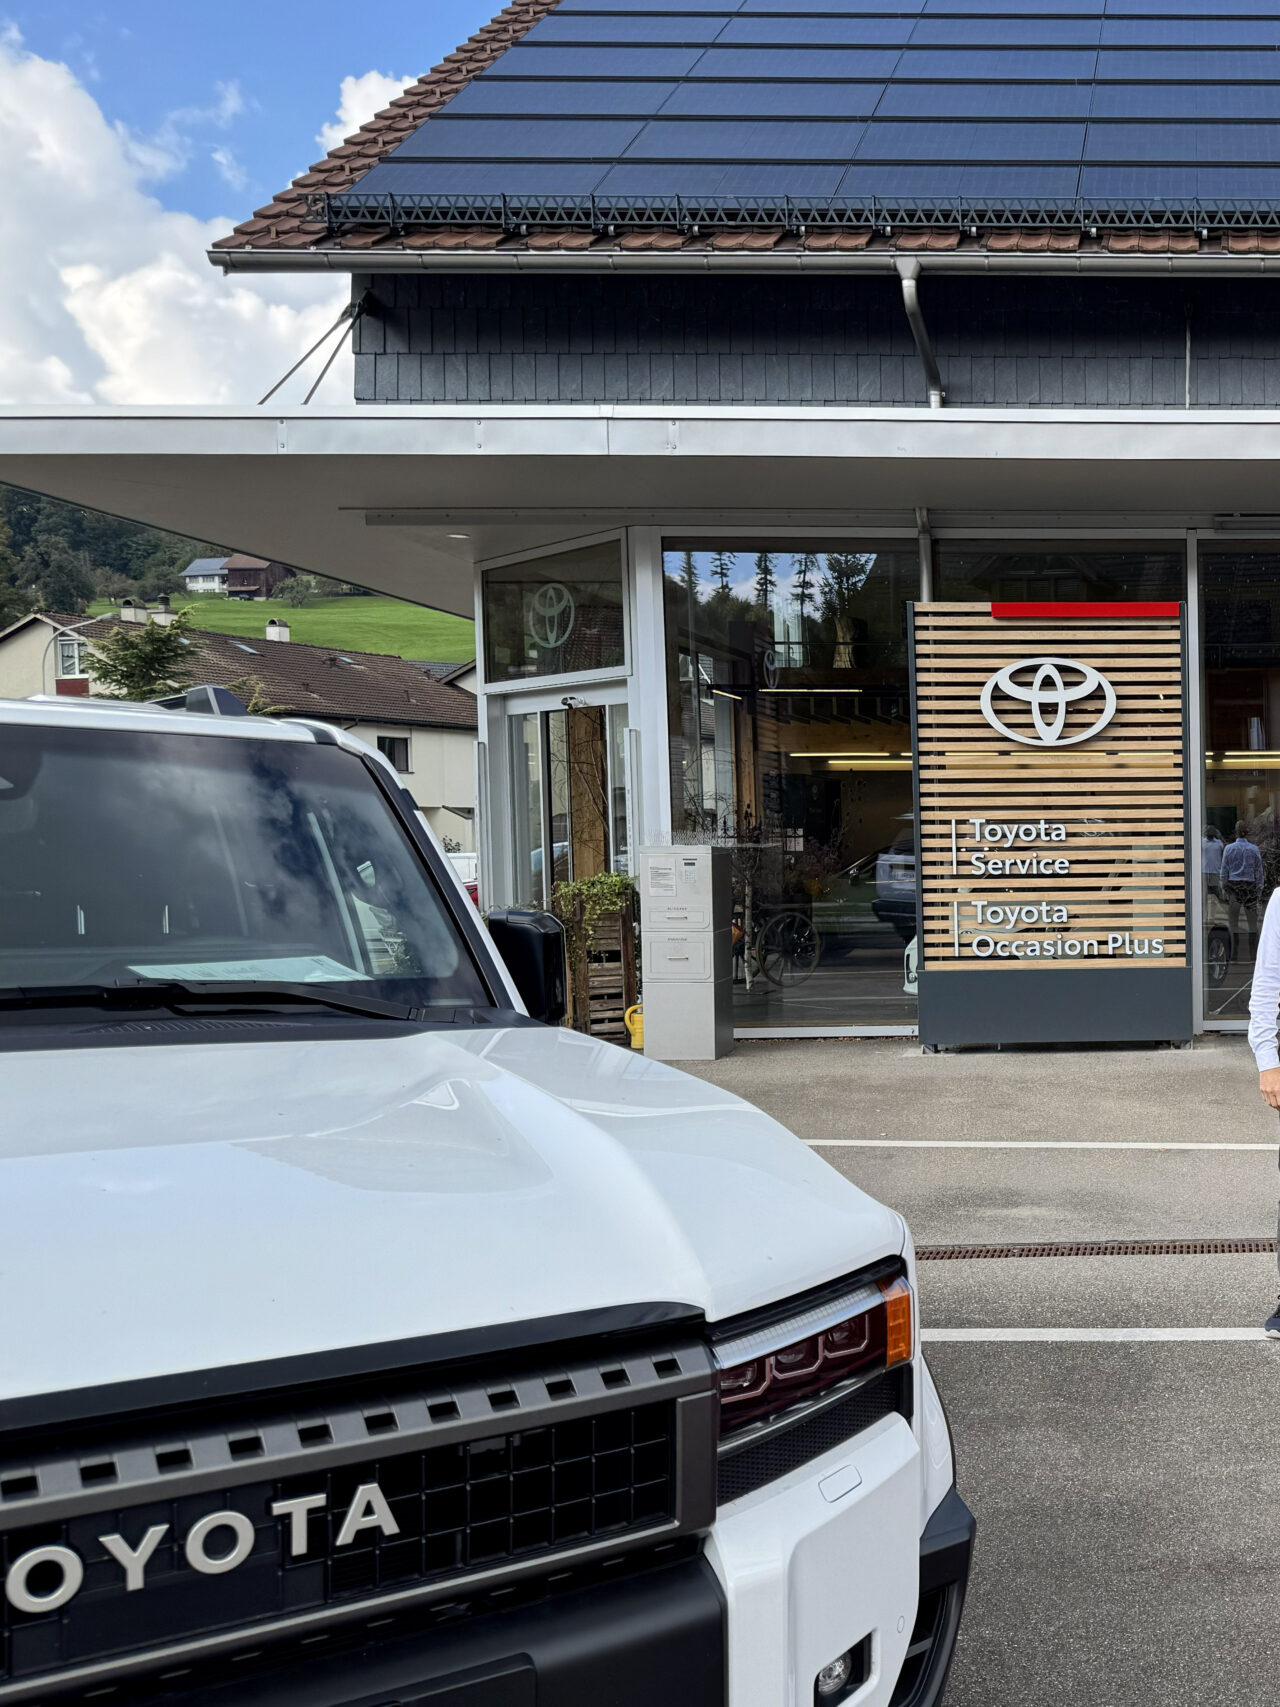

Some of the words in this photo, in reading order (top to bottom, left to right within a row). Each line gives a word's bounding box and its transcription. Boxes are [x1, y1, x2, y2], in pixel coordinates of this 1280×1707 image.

[969, 818, 1067, 848] Toyota
[970, 852, 1070, 875] Service
[971, 900, 1069, 931] Toyota
[972, 934, 1098, 957] Occasion
[1107, 932, 1164, 955] Plus
[6, 1484, 400, 1613] OYOTA
